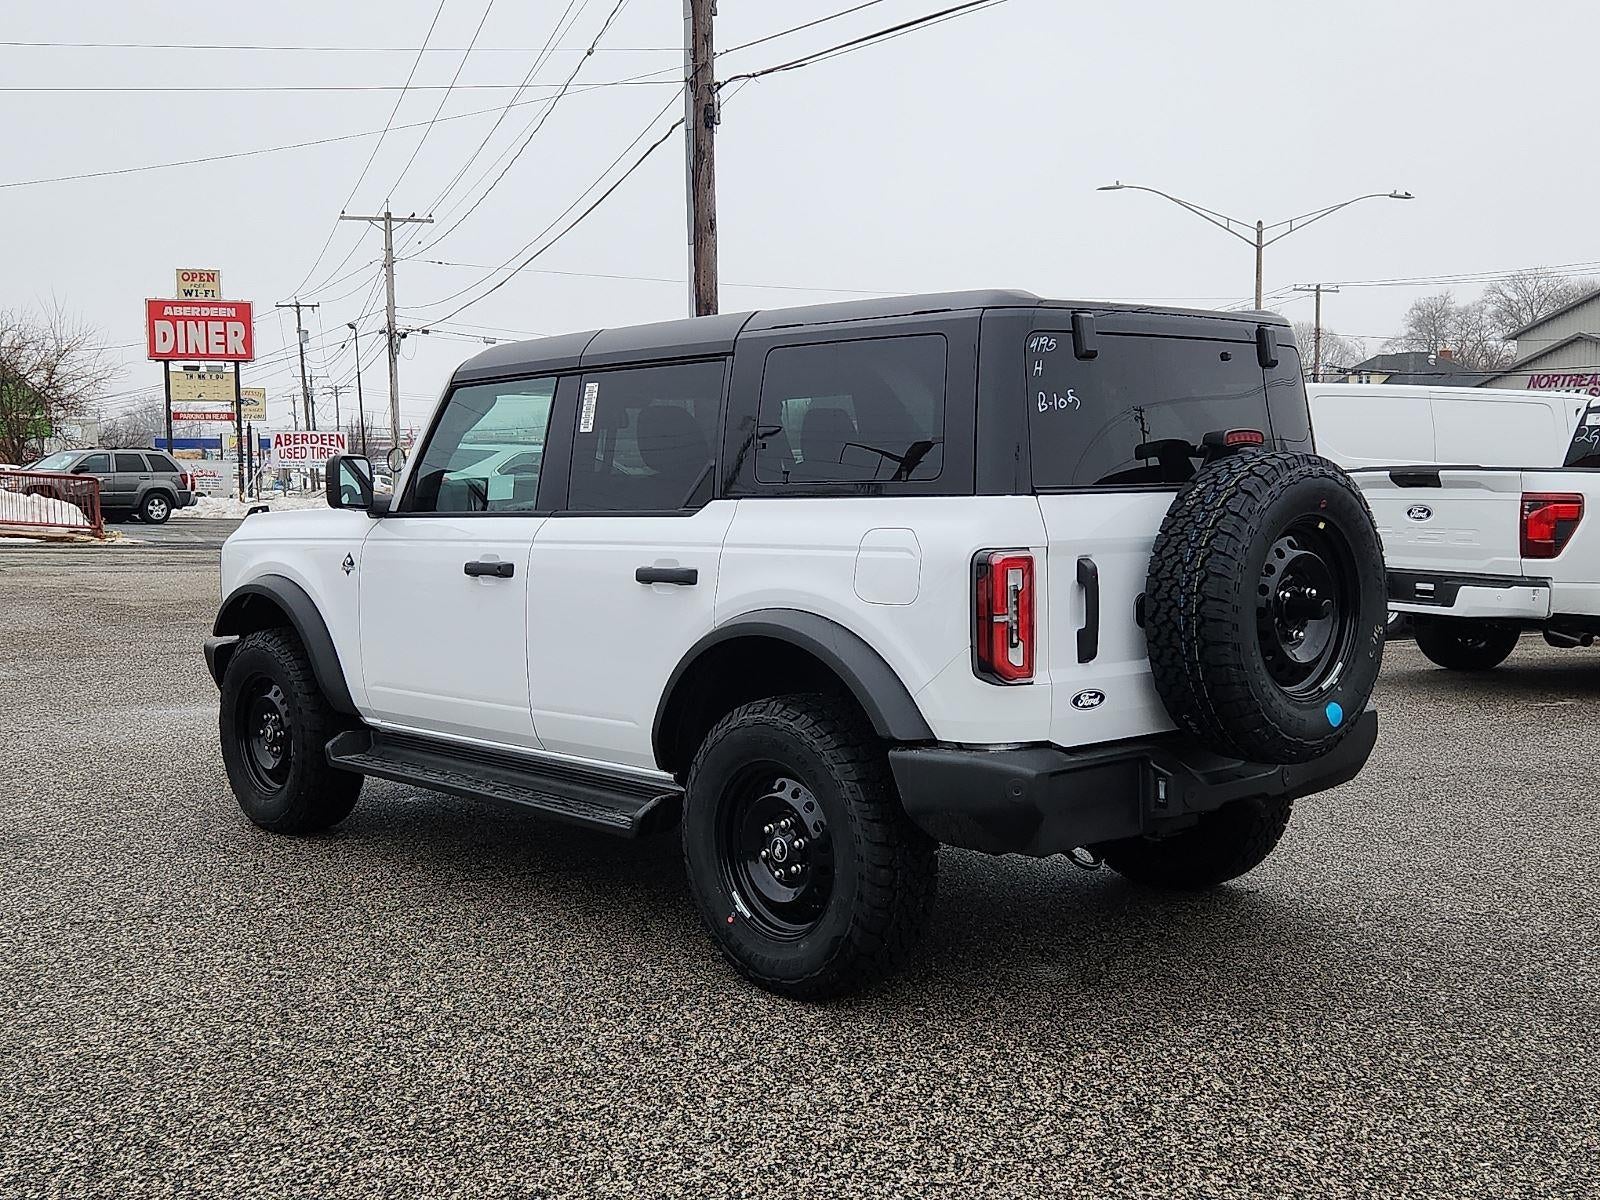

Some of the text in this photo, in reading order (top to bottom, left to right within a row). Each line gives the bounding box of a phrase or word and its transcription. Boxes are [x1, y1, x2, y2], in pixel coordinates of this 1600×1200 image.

[181, 272, 216, 282] OPEN
[183, 289, 216, 298] WI-FI
[163, 306, 236, 317] ABERDEEN
[154, 320, 247, 354] DINER
[1033, 360, 1043, 376] H
[1527, 374, 1600, 389] NORTHEA
[274, 433, 345, 449] ABERDEEN
[279, 447, 307, 459] USED
